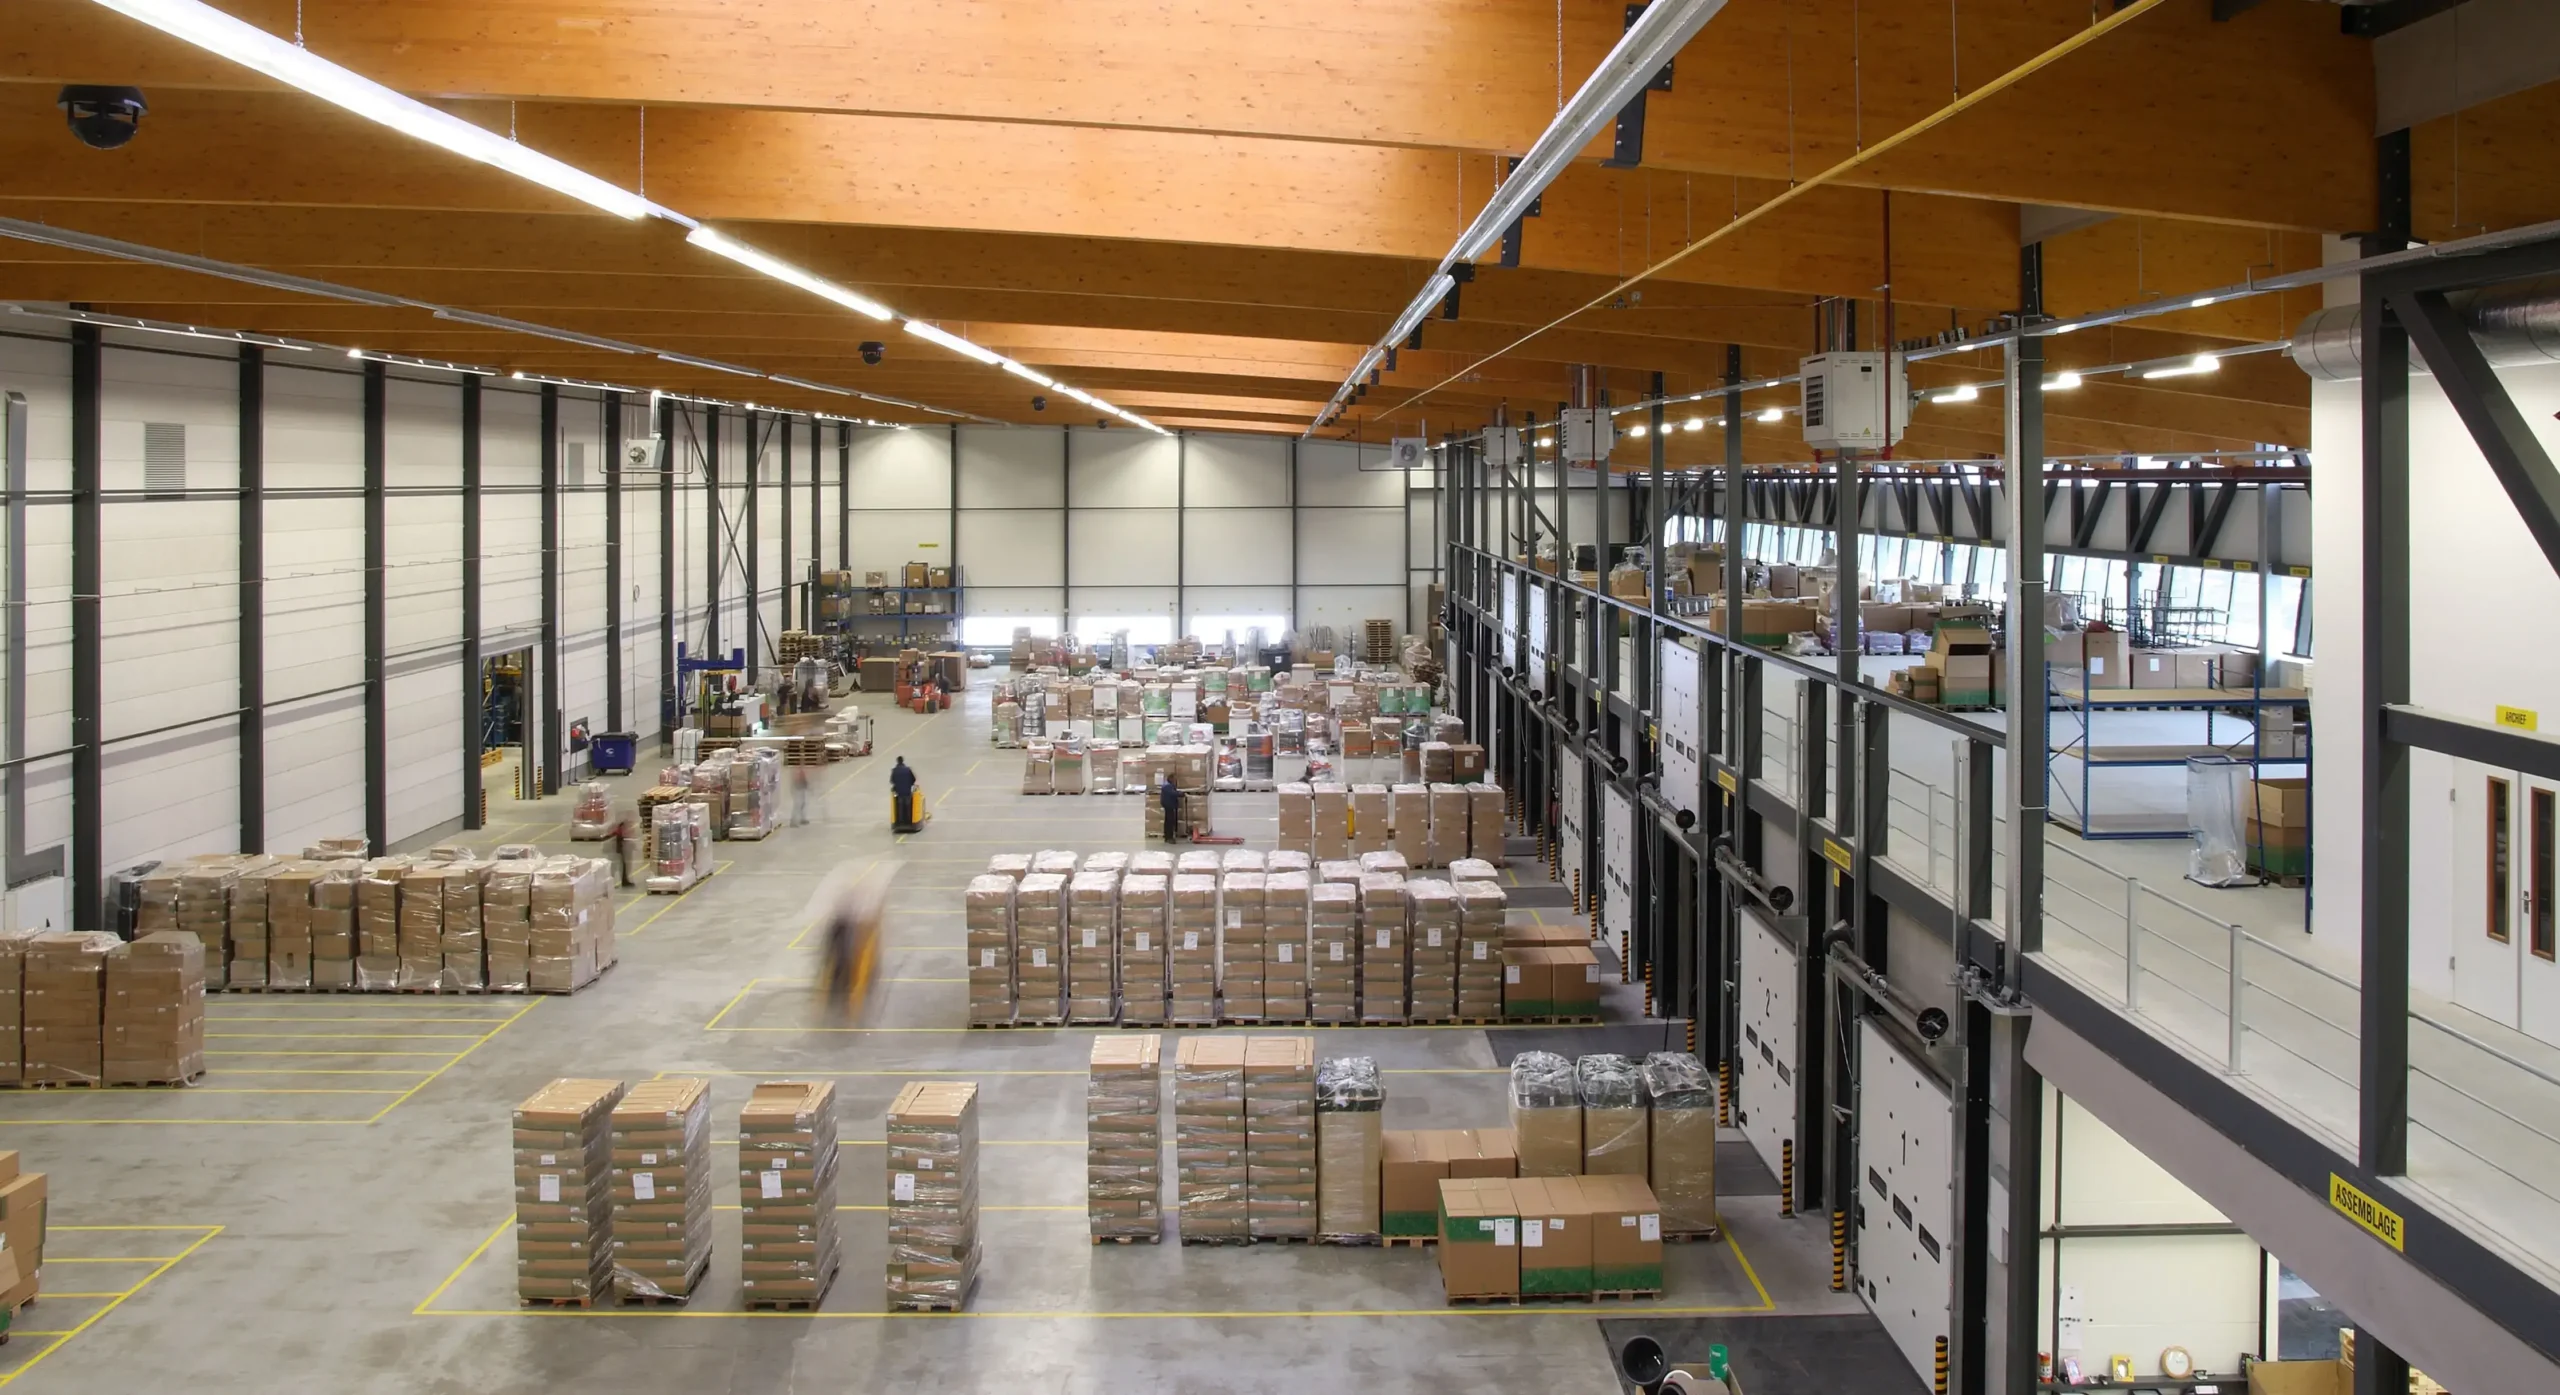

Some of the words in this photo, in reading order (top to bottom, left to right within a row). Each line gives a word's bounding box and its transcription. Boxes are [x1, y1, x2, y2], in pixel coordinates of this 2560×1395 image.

[2505, 711, 2526, 725] ARCHIEF
[1765, 988, 1770, 1018] 2
[1901, 1130, 1906, 1166] 1
[2335, 1183, 2396, 1241] ASSEMBLAGE
